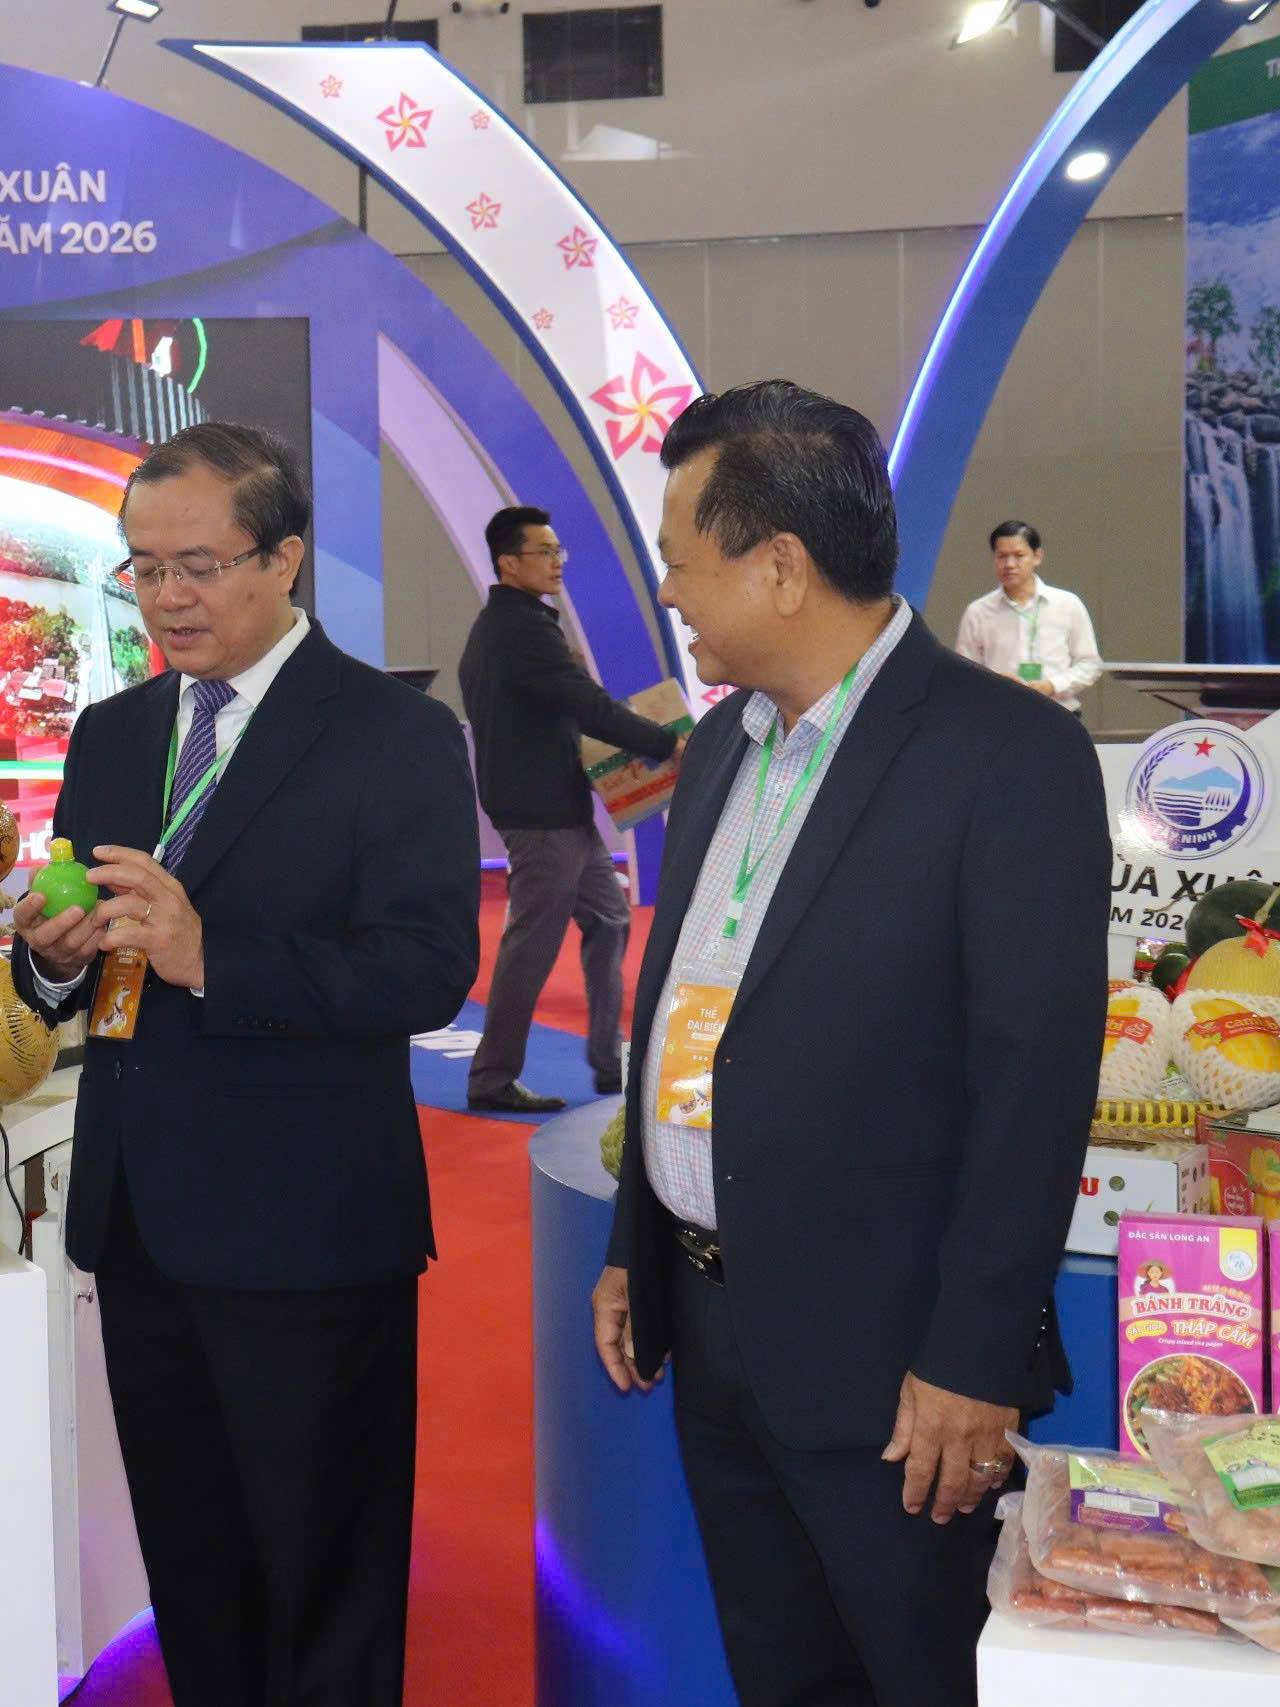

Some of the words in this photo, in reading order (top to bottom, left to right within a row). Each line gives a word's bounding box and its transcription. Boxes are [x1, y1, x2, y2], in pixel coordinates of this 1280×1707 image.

[59, 219, 158, 254] 2026
[1181, 829, 1218, 844] NINH
[1111, 853, 1159, 898] ÙA
[1140, 911, 1184, 932] 202
[1169, 1233, 1195, 1242] LONG
[1196, 1234, 1210, 1243] AN
[1135, 1295, 1183, 1314] BÁNH
